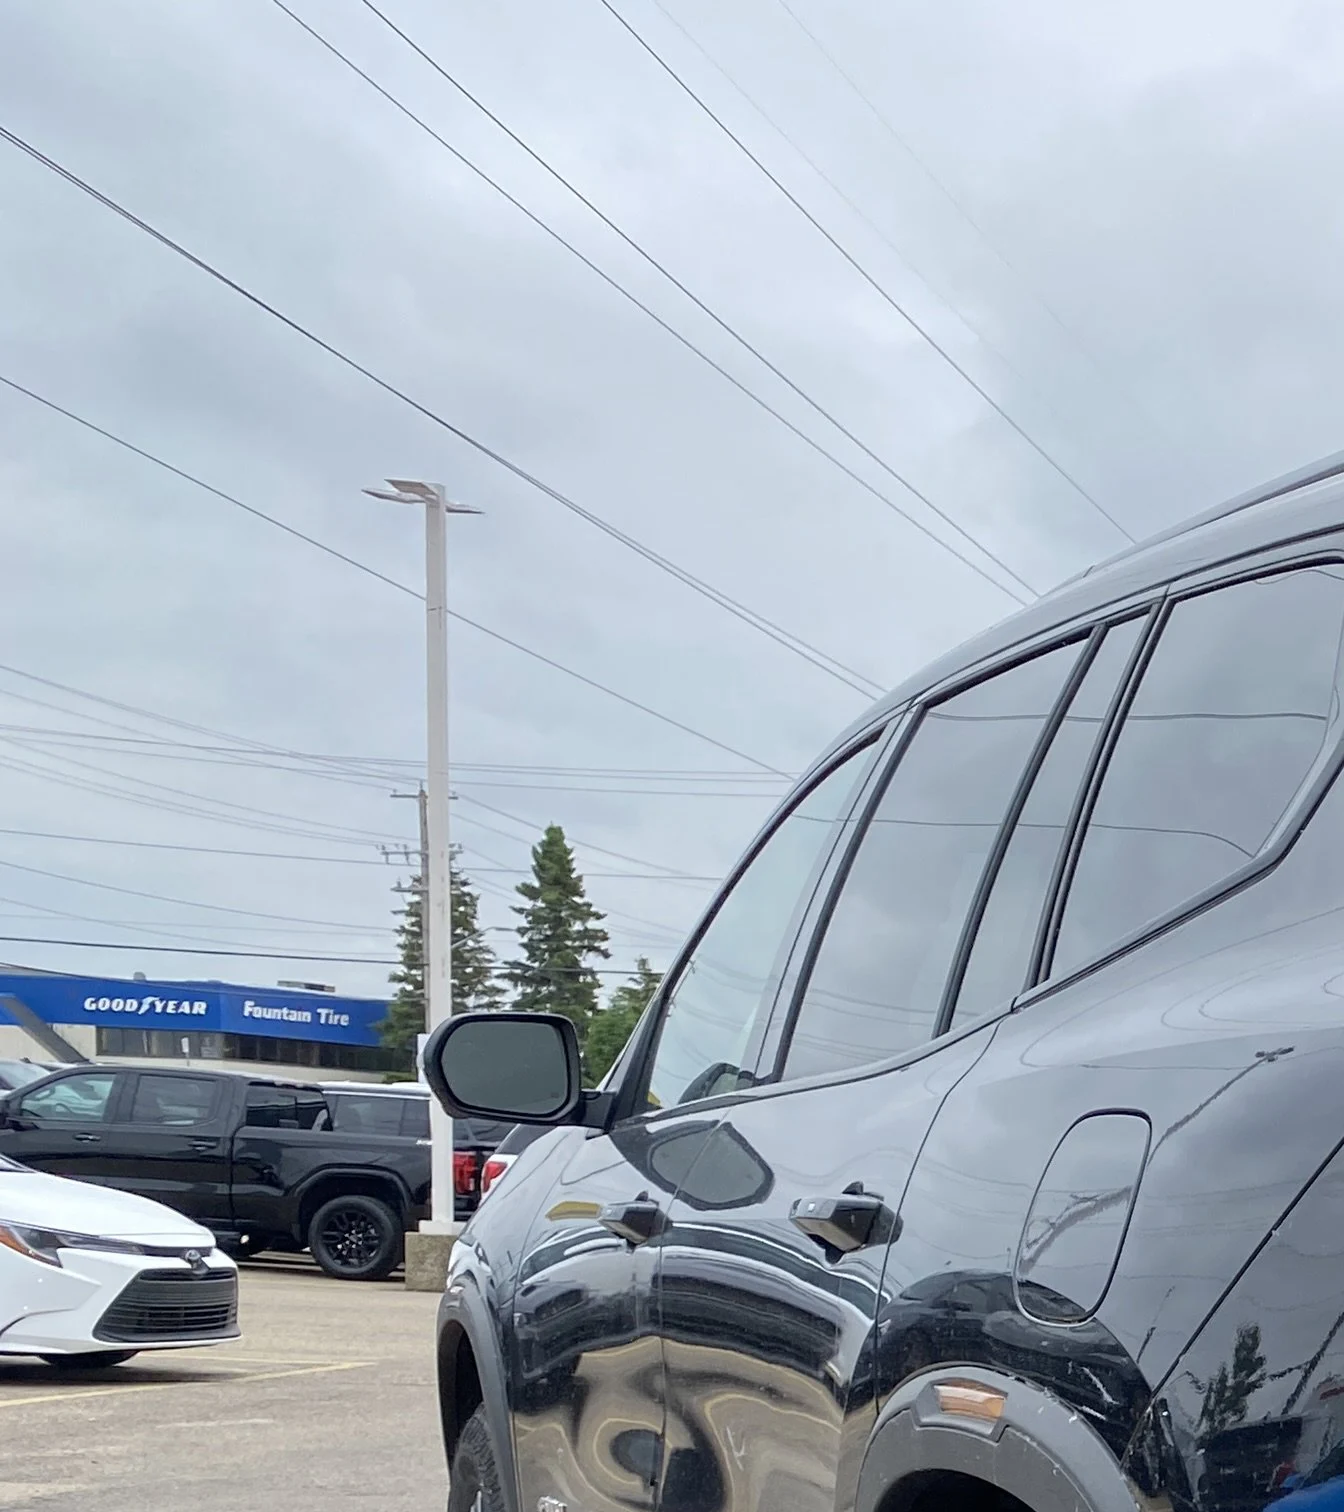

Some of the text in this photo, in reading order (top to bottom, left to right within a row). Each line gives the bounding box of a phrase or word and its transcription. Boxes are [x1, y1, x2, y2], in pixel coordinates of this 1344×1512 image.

[84, 995, 207, 1016] GOODYEAR
[242, 1000, 349, 1026] Fountain Tire
